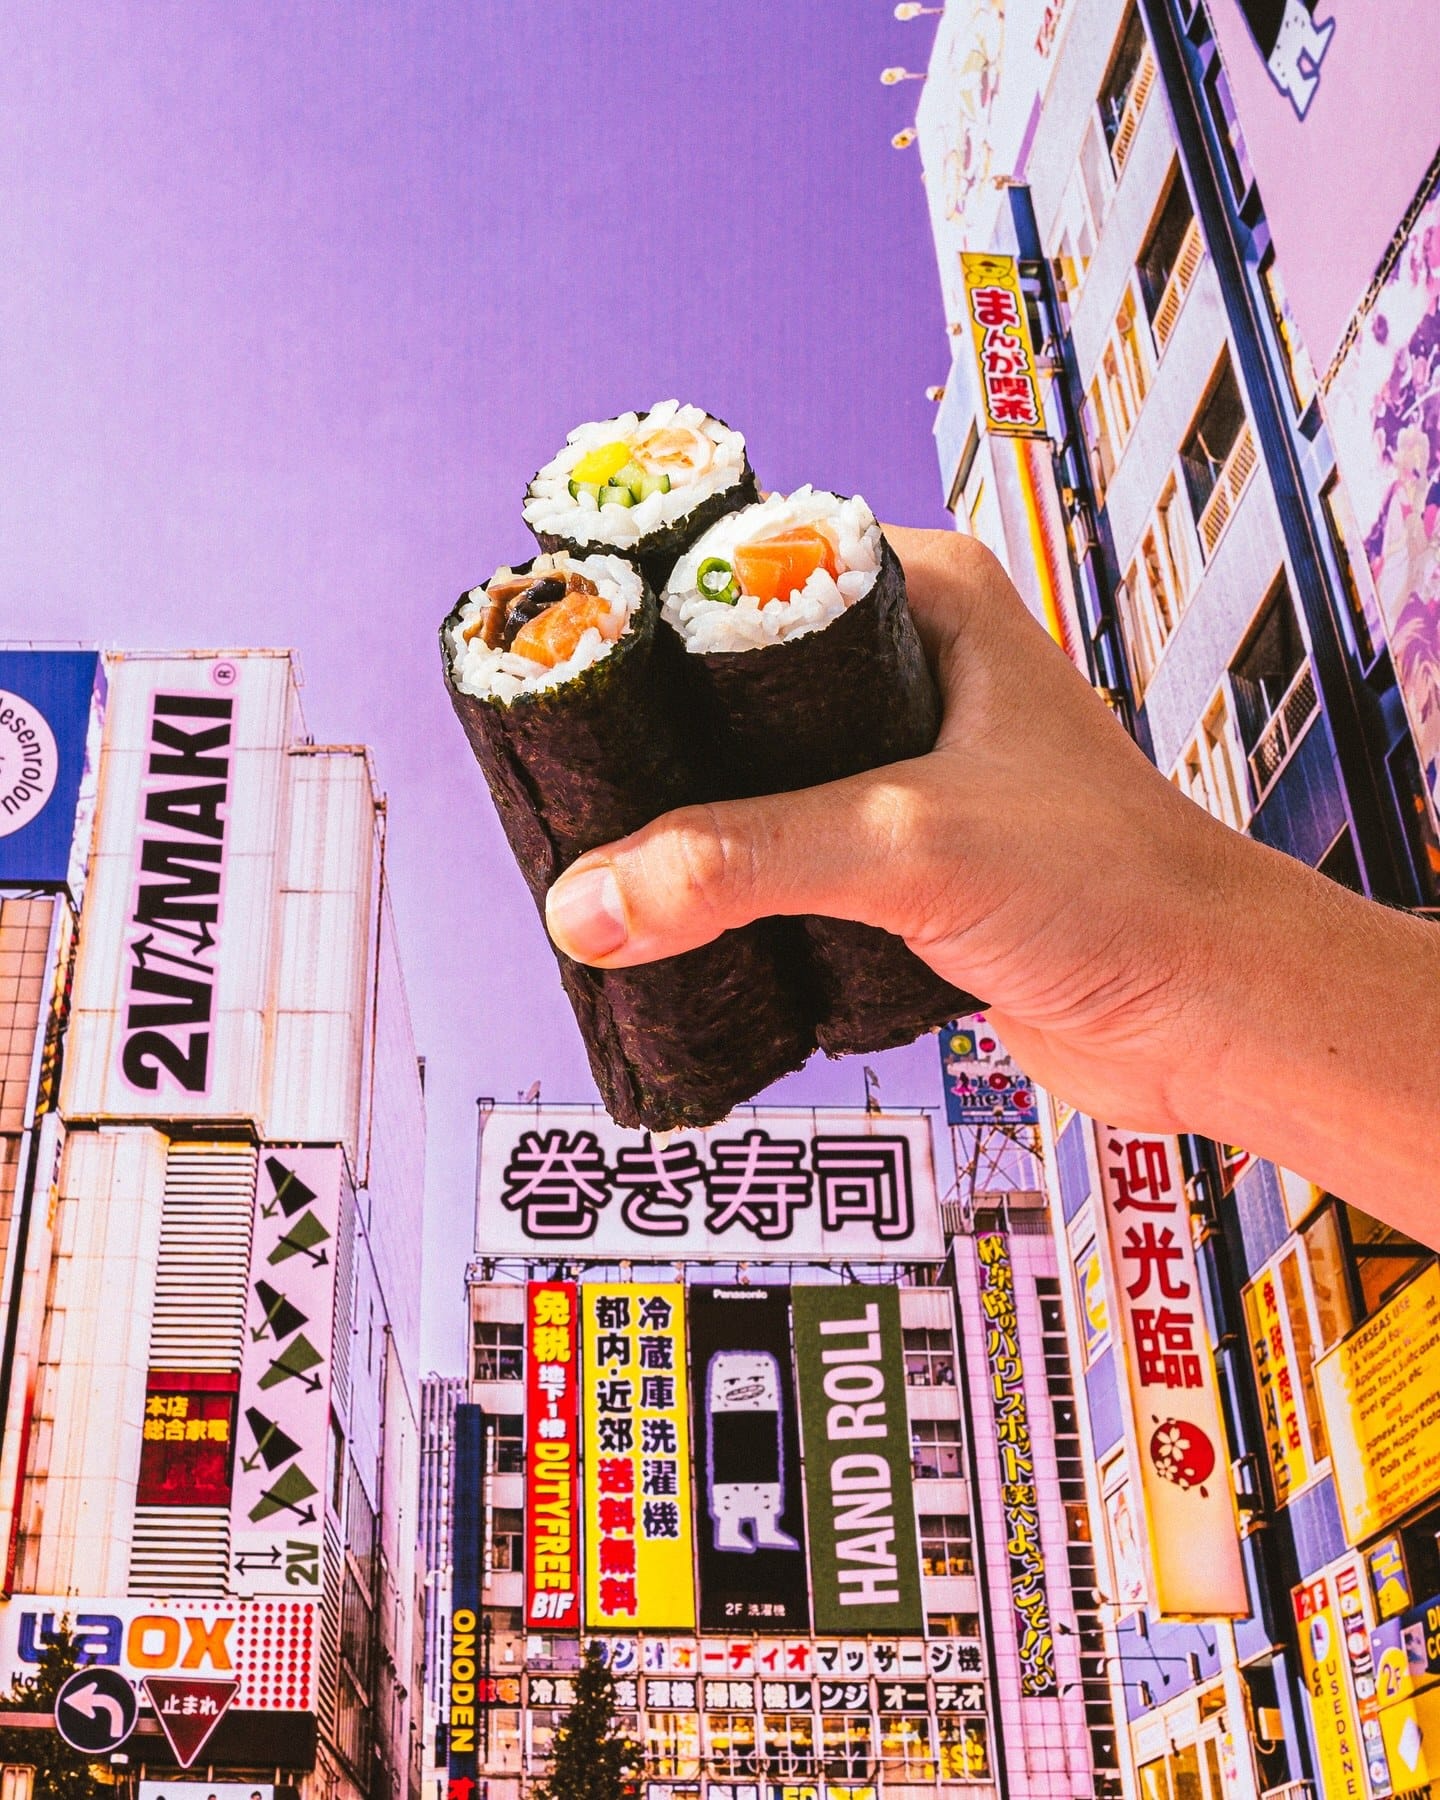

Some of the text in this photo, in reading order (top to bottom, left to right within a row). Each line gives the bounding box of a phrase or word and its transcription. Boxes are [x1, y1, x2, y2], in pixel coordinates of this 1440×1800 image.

[973, 288, 1036, 422] まんが喫茶
[0, 697, 44, 816] esenrolou
[503, 1129, 914, 1240] 巻き寿司
[1106, 1126, 1204, 1389] 迎光臨
[713, 1289, 768, 1299] Panasonic
[533, 1290, 571, 1362] 免税
[143, 1418, 229, 1441] 総合家電
[144, 1395, 189, 1418] 本店
[819, 1303, 899, 1606] HAND ROLL
[285, 1539, 319, 1586] 2V
[531, 1592, 574, 1618] B1F
[725, 1602, 743, 1616] 2F
[1300, 1582, 1325, 1619] 2F
[450, 1608, 477, 1753] ONODEN
[160, 1693, 220, 1716] 止まれ
